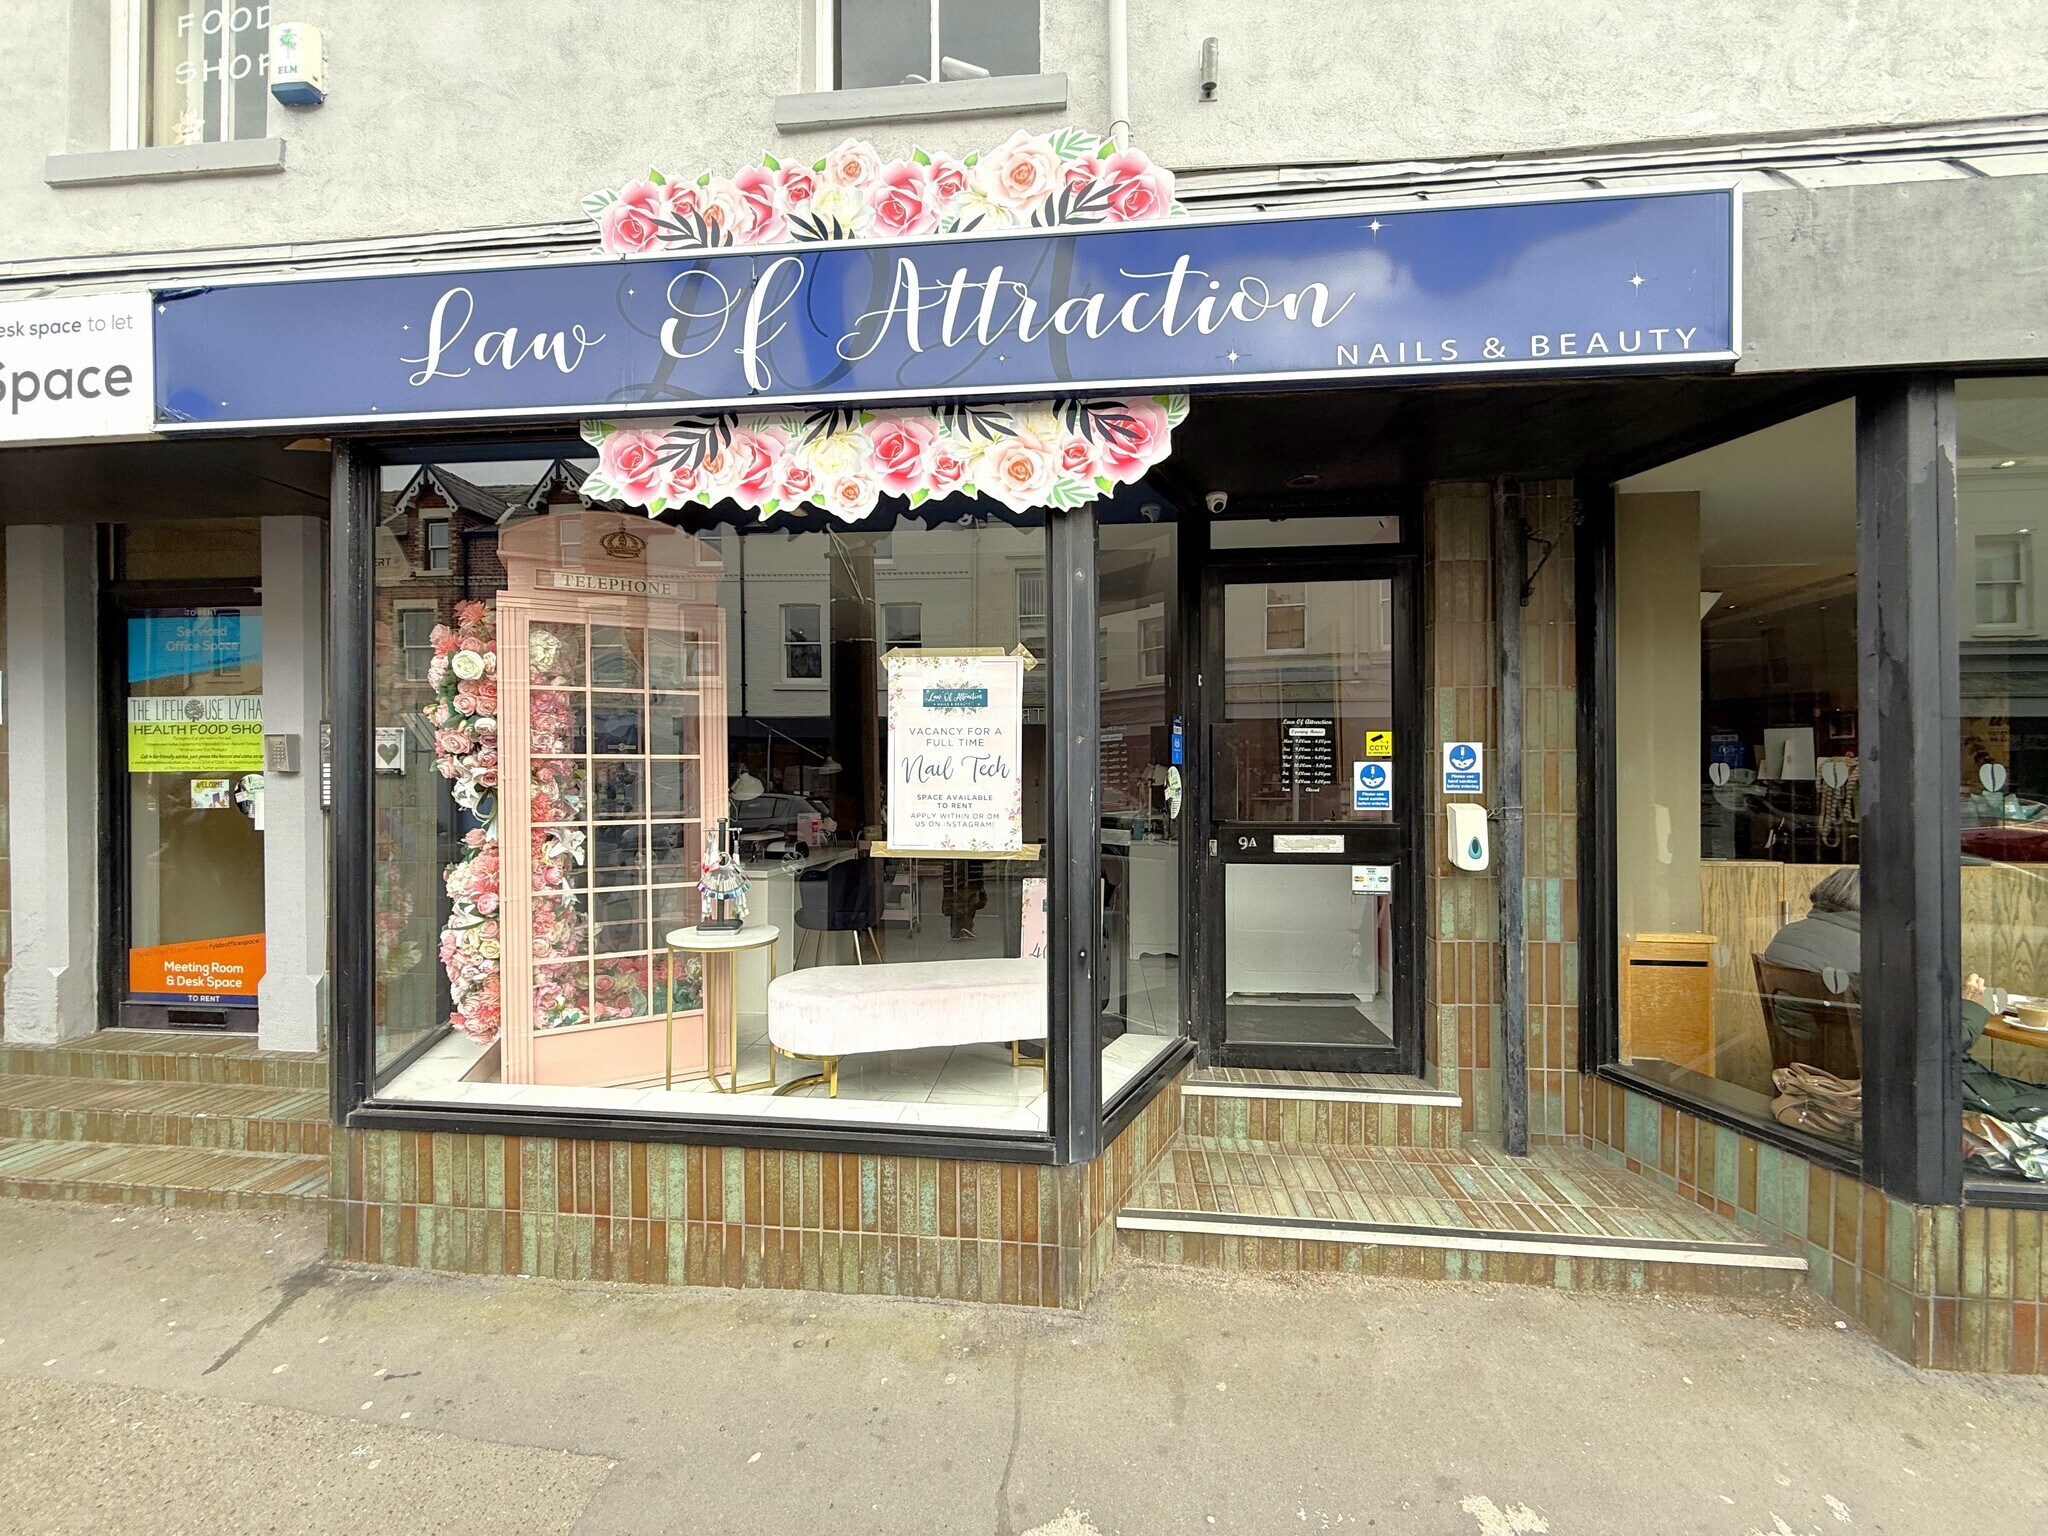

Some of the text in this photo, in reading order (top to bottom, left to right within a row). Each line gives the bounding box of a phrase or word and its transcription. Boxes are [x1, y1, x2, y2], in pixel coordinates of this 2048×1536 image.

[278, 65, 298, 75] ELM
[29, 320, 82, 339] space
[88, 316, 107, 332] to
[111, 314, 133, 330] let
[400, 254, 1356, 392] Law Of Attraction
[1337, 327, 1697, 366] NAILS & BEAUTY
[562, 574, 671, 595] TELEPHONE
[177, 626, 228, 637] Serviced
[165, 640, 239, 653] Office Space
[132, 699, 151, 721] THE
[134, 724, 262, 735] HEALTH FOOD SHO
[909, 728, 1002, 736] VACANCY FOR A
[926, 738, 984, 746] FULL TIME
[901, 753, 1010, 784] Nail Tech
[196, 780, 224, 788] WELCOME
[1238, 836, 1257, 850] 9A
[164, 961, 244, 976] Meeting Room
[166, 976, 243, 989] & Desk Space
